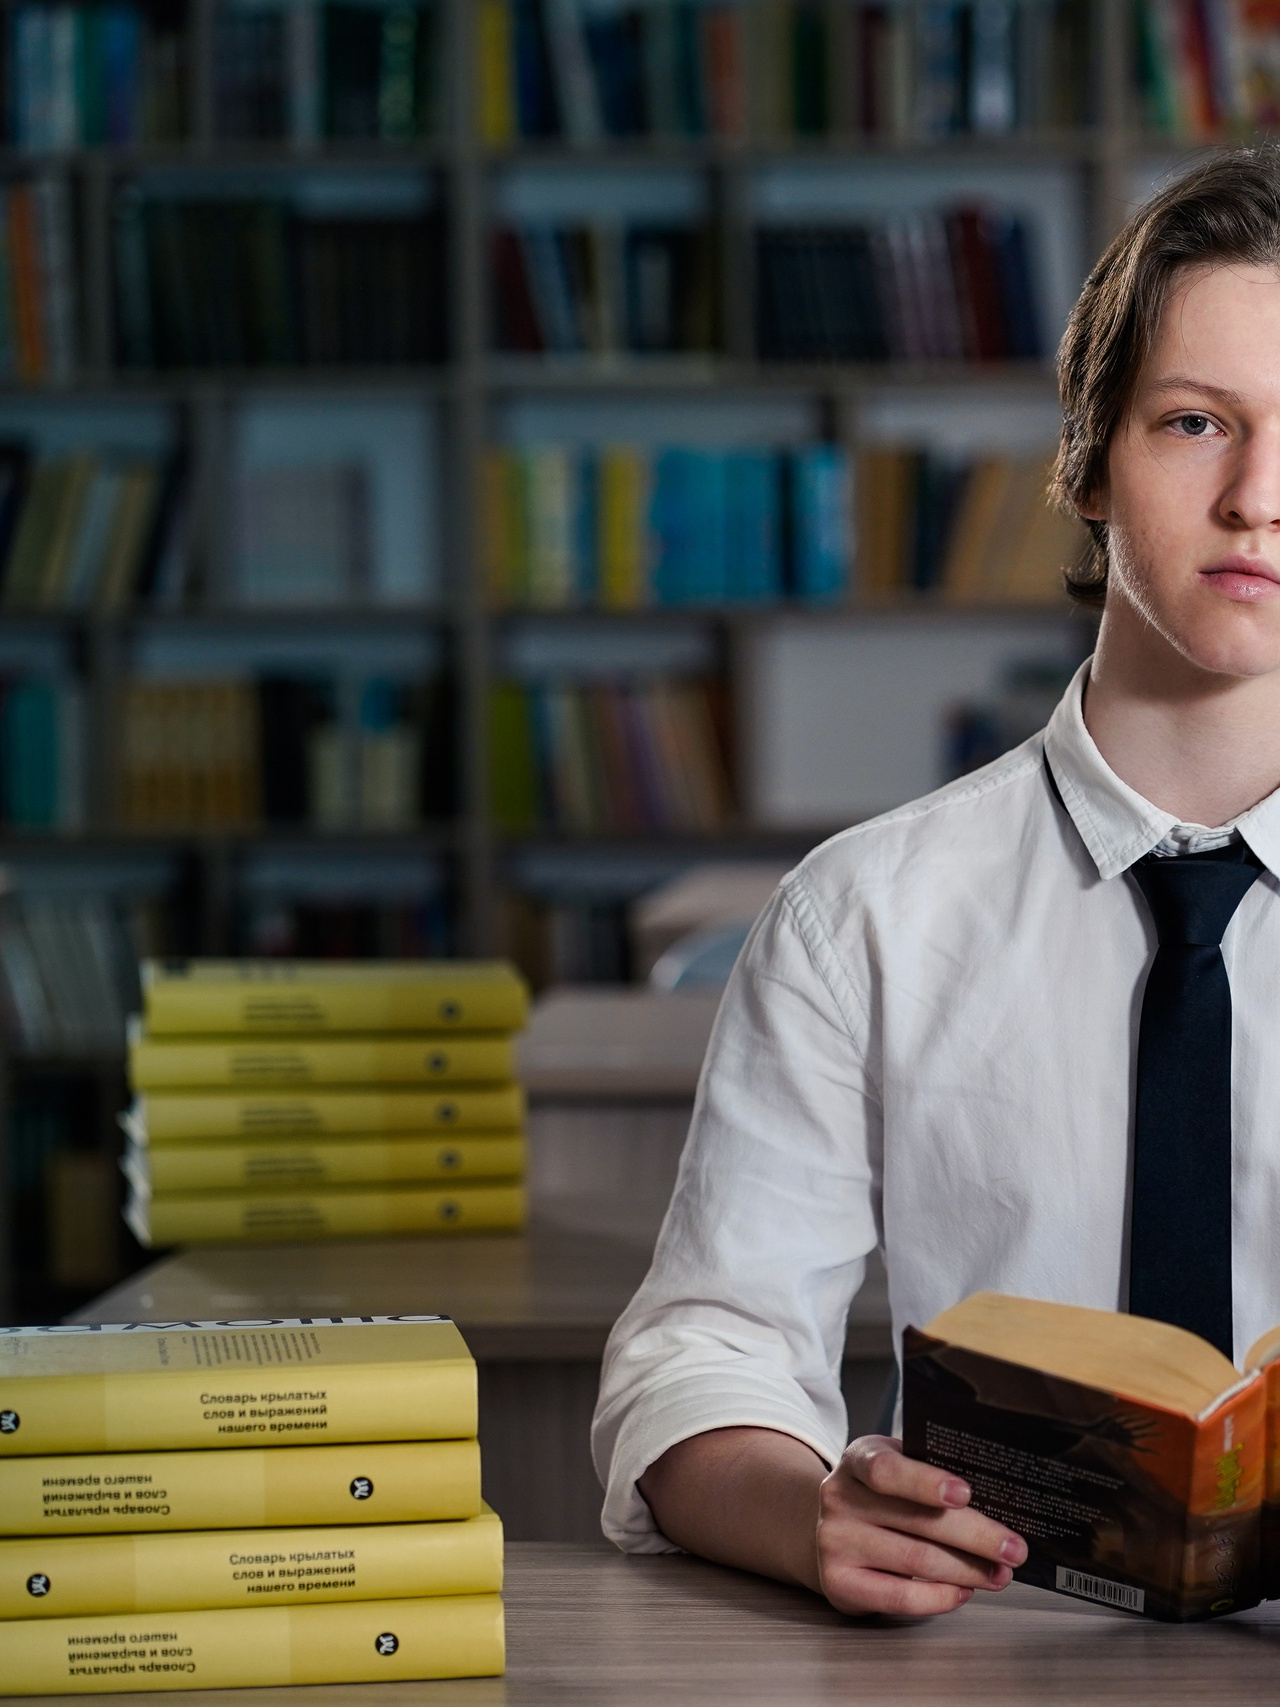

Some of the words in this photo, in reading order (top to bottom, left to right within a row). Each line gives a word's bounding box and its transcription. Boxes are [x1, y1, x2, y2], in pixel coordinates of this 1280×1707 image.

[200, 1392, 257, 1405] Словарь
[260, 1391, 327, 1405] крылатых
[203, 1409, 235, 1419] слов
[238, 1410, 246, 1418] и
[250, 1404, 327, 1419] выражений
[218, 1423, 266, 1433] нашего
[270, 1421, 328, 1433] времени
[42, 1474, 101, 1486] времени
[103, 1475, 152, 1485] нашего
[42, 1490, 121, 1503] выражений
[124, 1491, 132, 1499] и
[135, 1490, 167, 1498] слов
[43, 1505, 110, 1517] крылатых
[113, 1505, 170, 1516] Словарь
[229, 1552, 286, 1565] Словарь
[289, 1549, 355, 1565] крылатых
[232, 1570, 264, 1580] слов
[267, 1570, 275, 1578] и
[278, 1564, 355, 1579] выражений
[247, 1582, 295, 1593] нашего
[298, 1580, 356, 1592] времени
[67, 1633, 126, 1645] времени
[129, 1632, 178, 1643] нашего
[68, 1647, 146, 1663] выражений
[149, 1649, 157, 1658] и
[161, 1648, 193, 1657] слов
[69, 1663, 136, 1676] крылатых
[138, 1662, 196, 1673] Словарь
